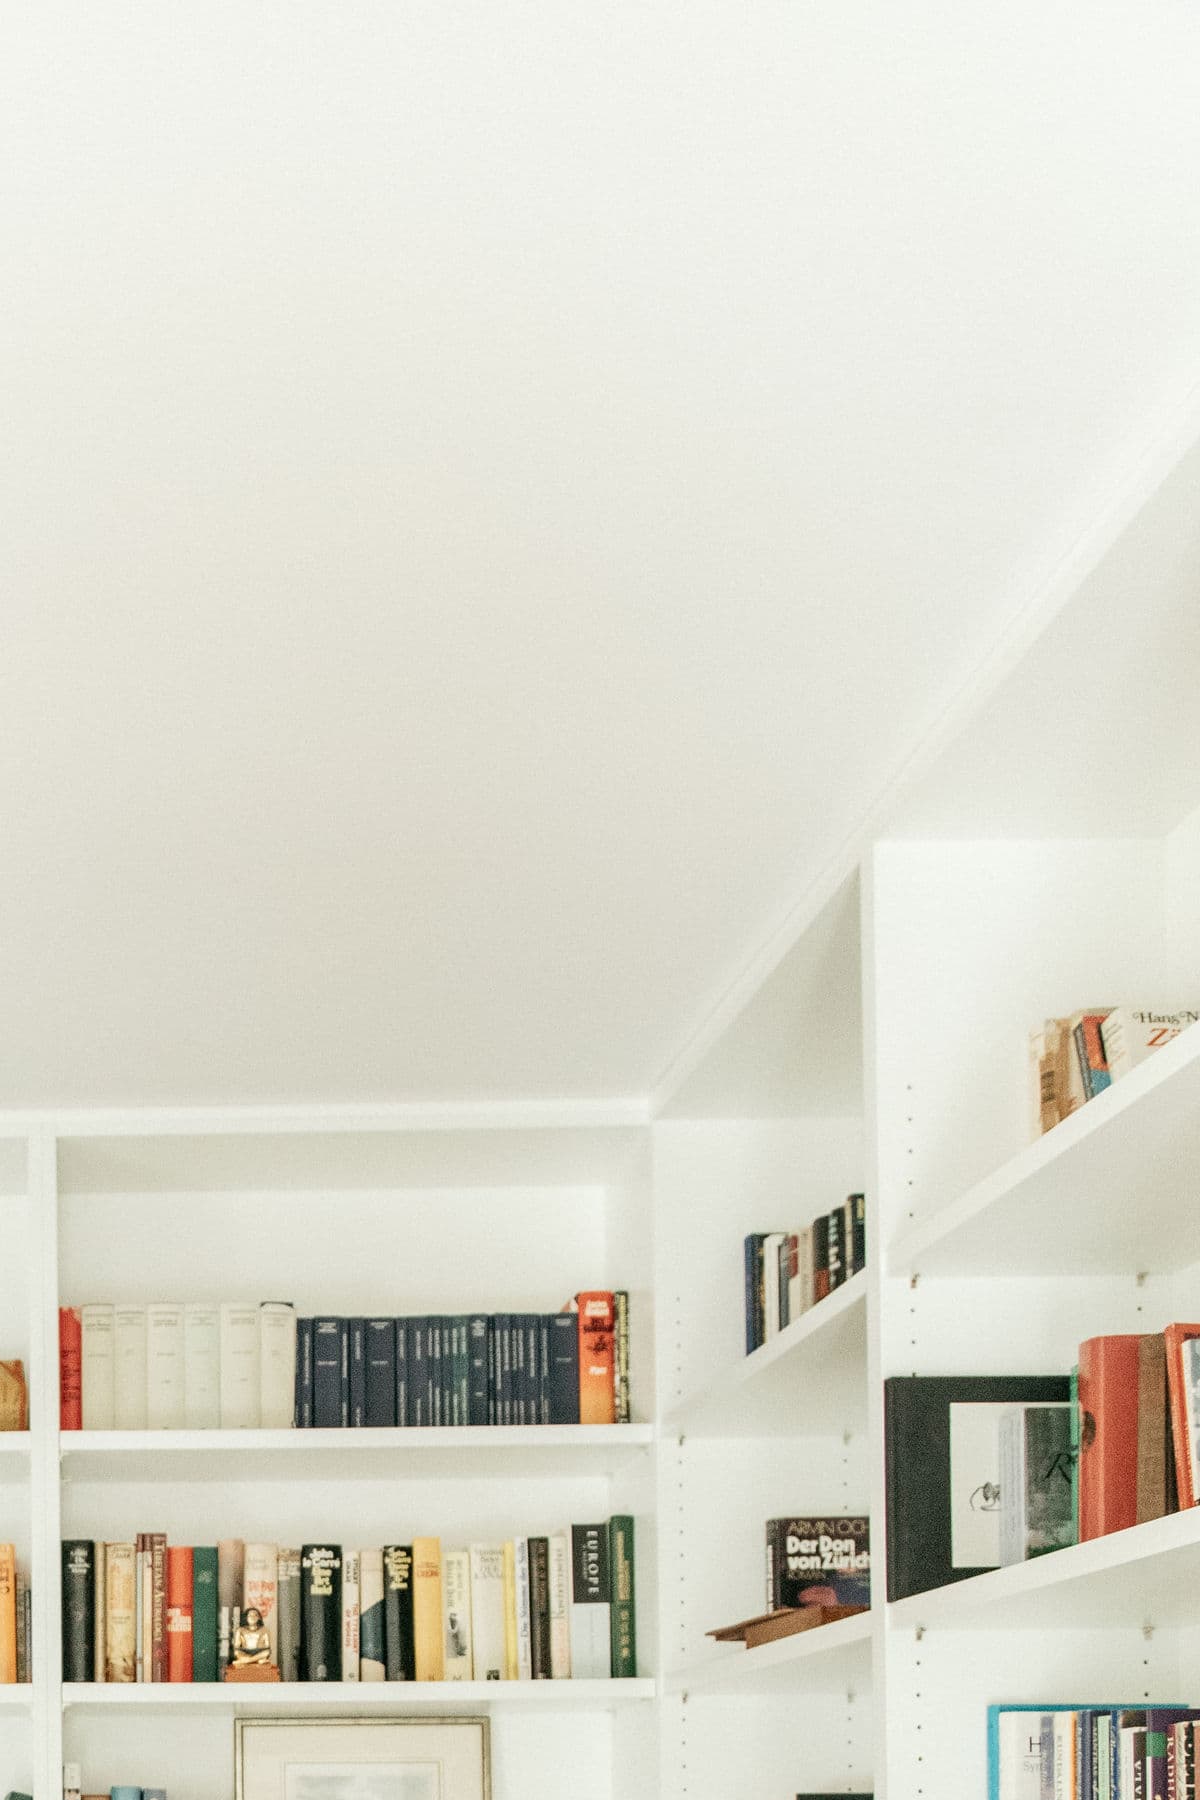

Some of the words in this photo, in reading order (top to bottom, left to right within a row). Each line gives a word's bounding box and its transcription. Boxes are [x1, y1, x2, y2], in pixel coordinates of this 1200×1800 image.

[786, 1535, 819, 1555] Der
[819, 1535, 856, 1555] Don
[586, 1530, 599, 1593] EUROPE
[787, 1555, 821, 1570] von
